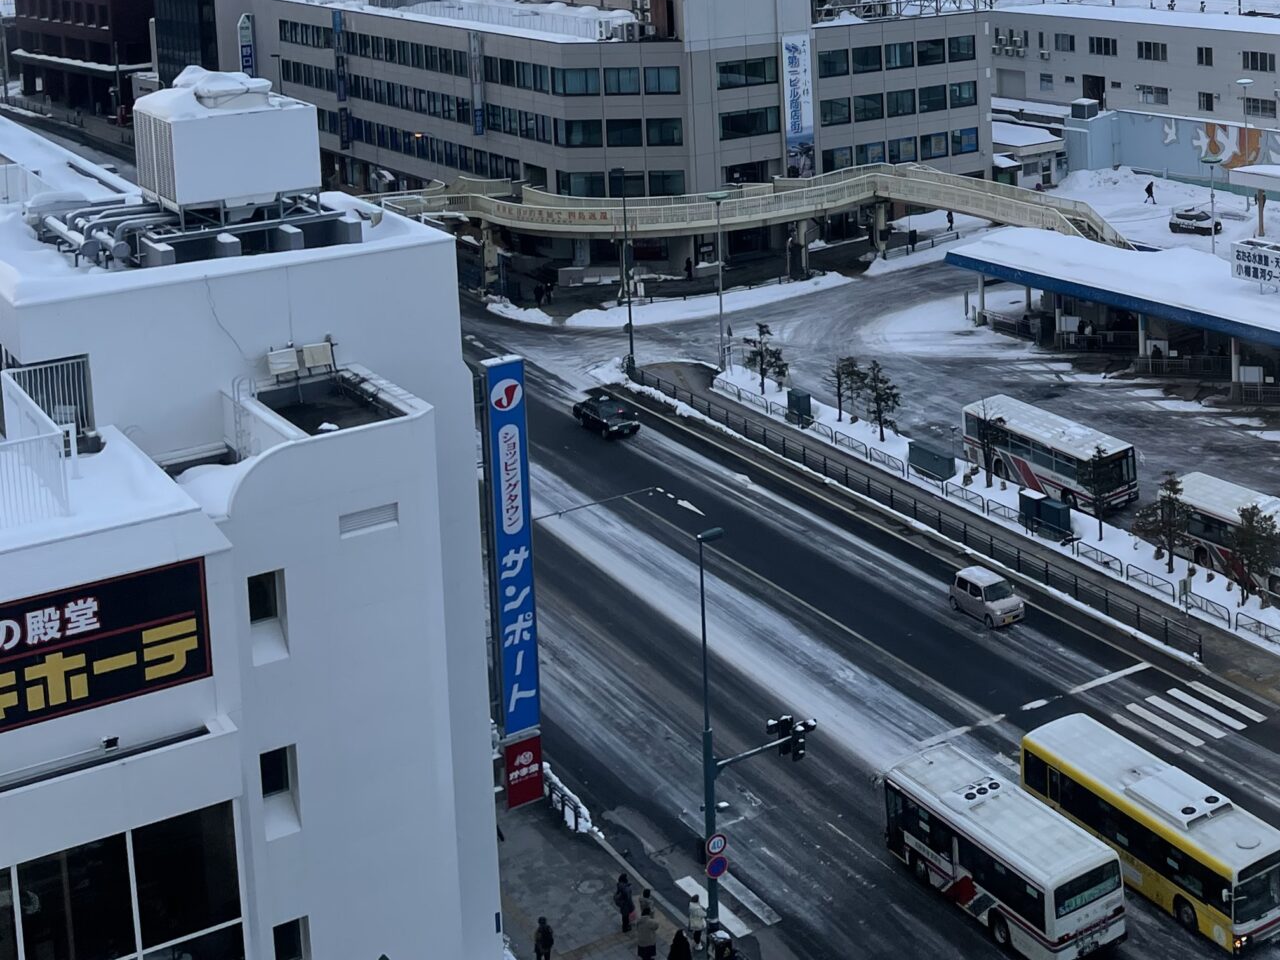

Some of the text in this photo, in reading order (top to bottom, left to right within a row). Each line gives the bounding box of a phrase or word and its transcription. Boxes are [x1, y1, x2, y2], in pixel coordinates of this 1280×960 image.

[503, 431, 520, 528] ショッピングタウン
[0, 597, 100, 650] の殿堂
[501, 546, 536, 713] サンポート
